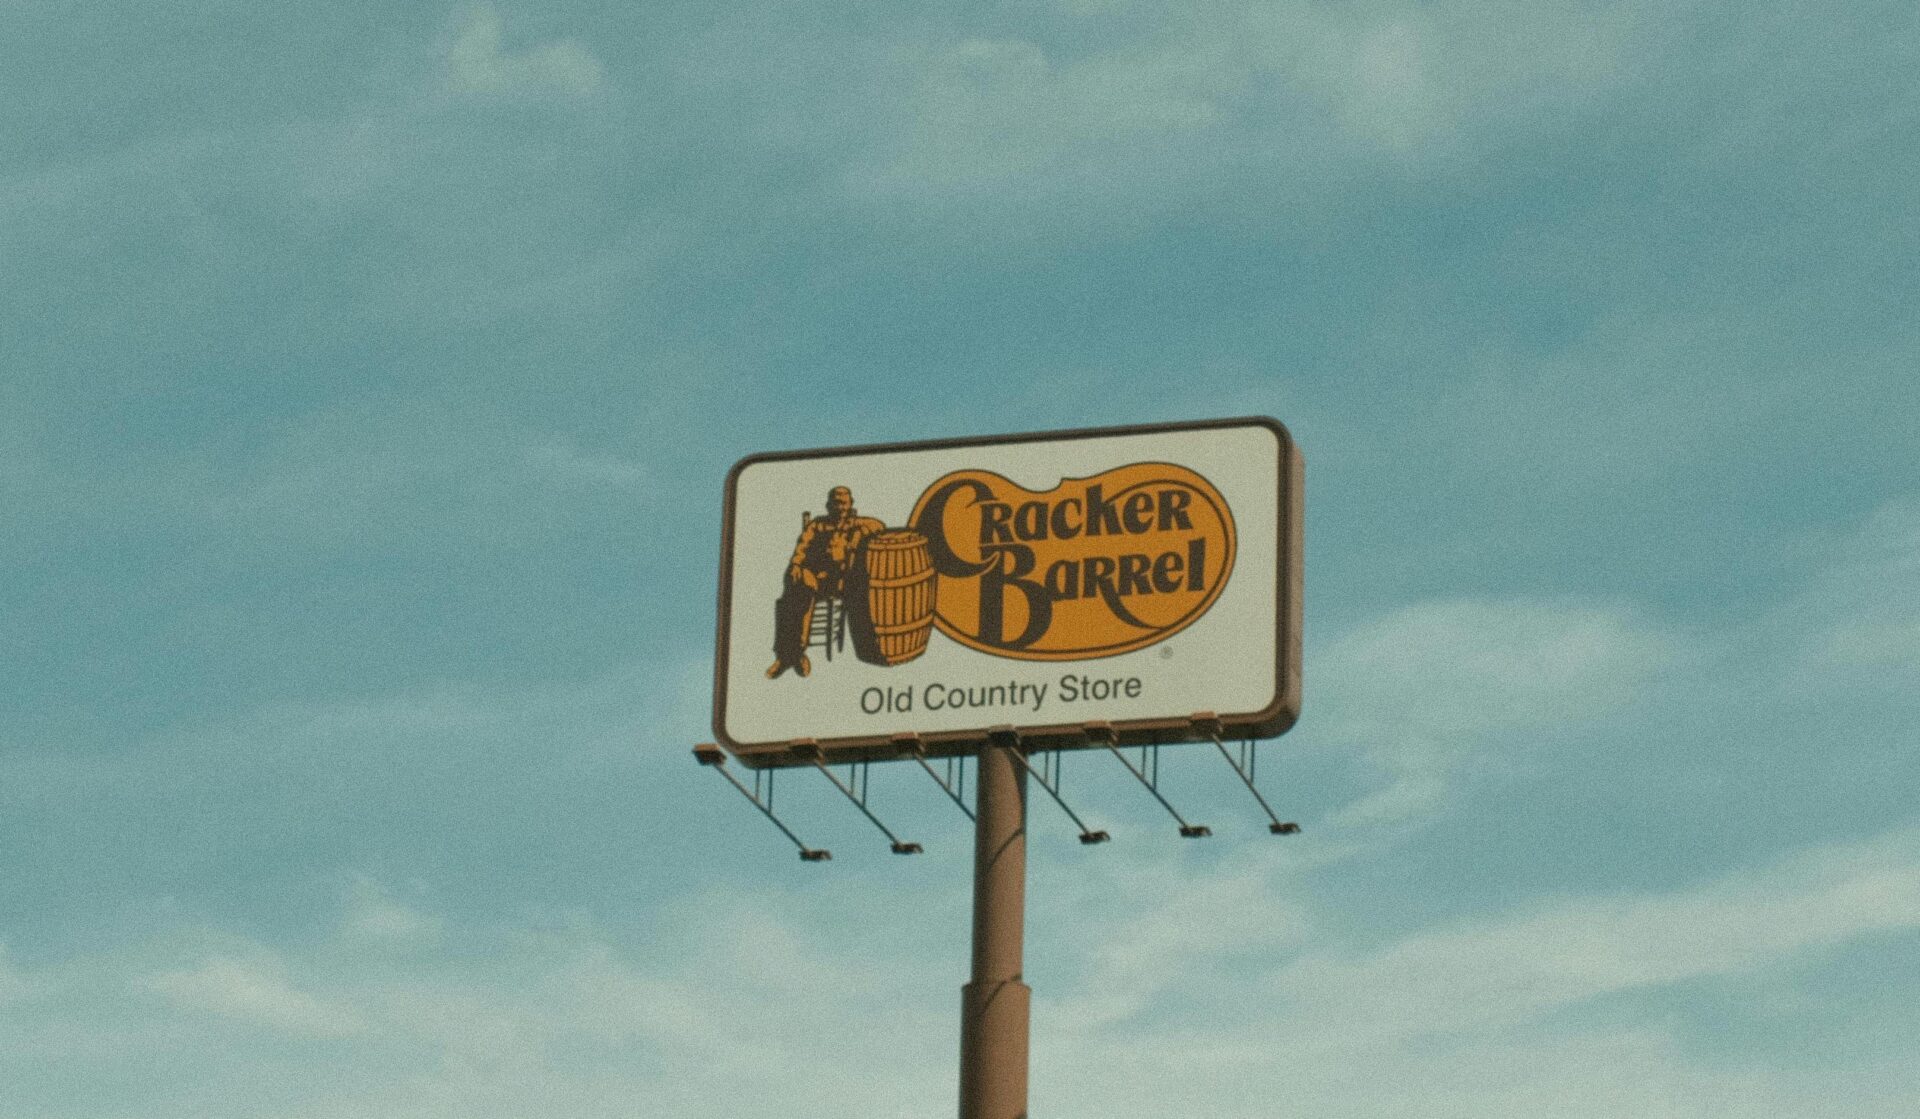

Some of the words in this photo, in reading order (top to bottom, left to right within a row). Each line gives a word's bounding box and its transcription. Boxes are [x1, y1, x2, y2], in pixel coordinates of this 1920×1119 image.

[978, 536, 1206, 651] Barrel
[860, 685, 913, 715] Old
[923, 680, 1048, 712] Country
[1058, 674, 1143, 703] Store
